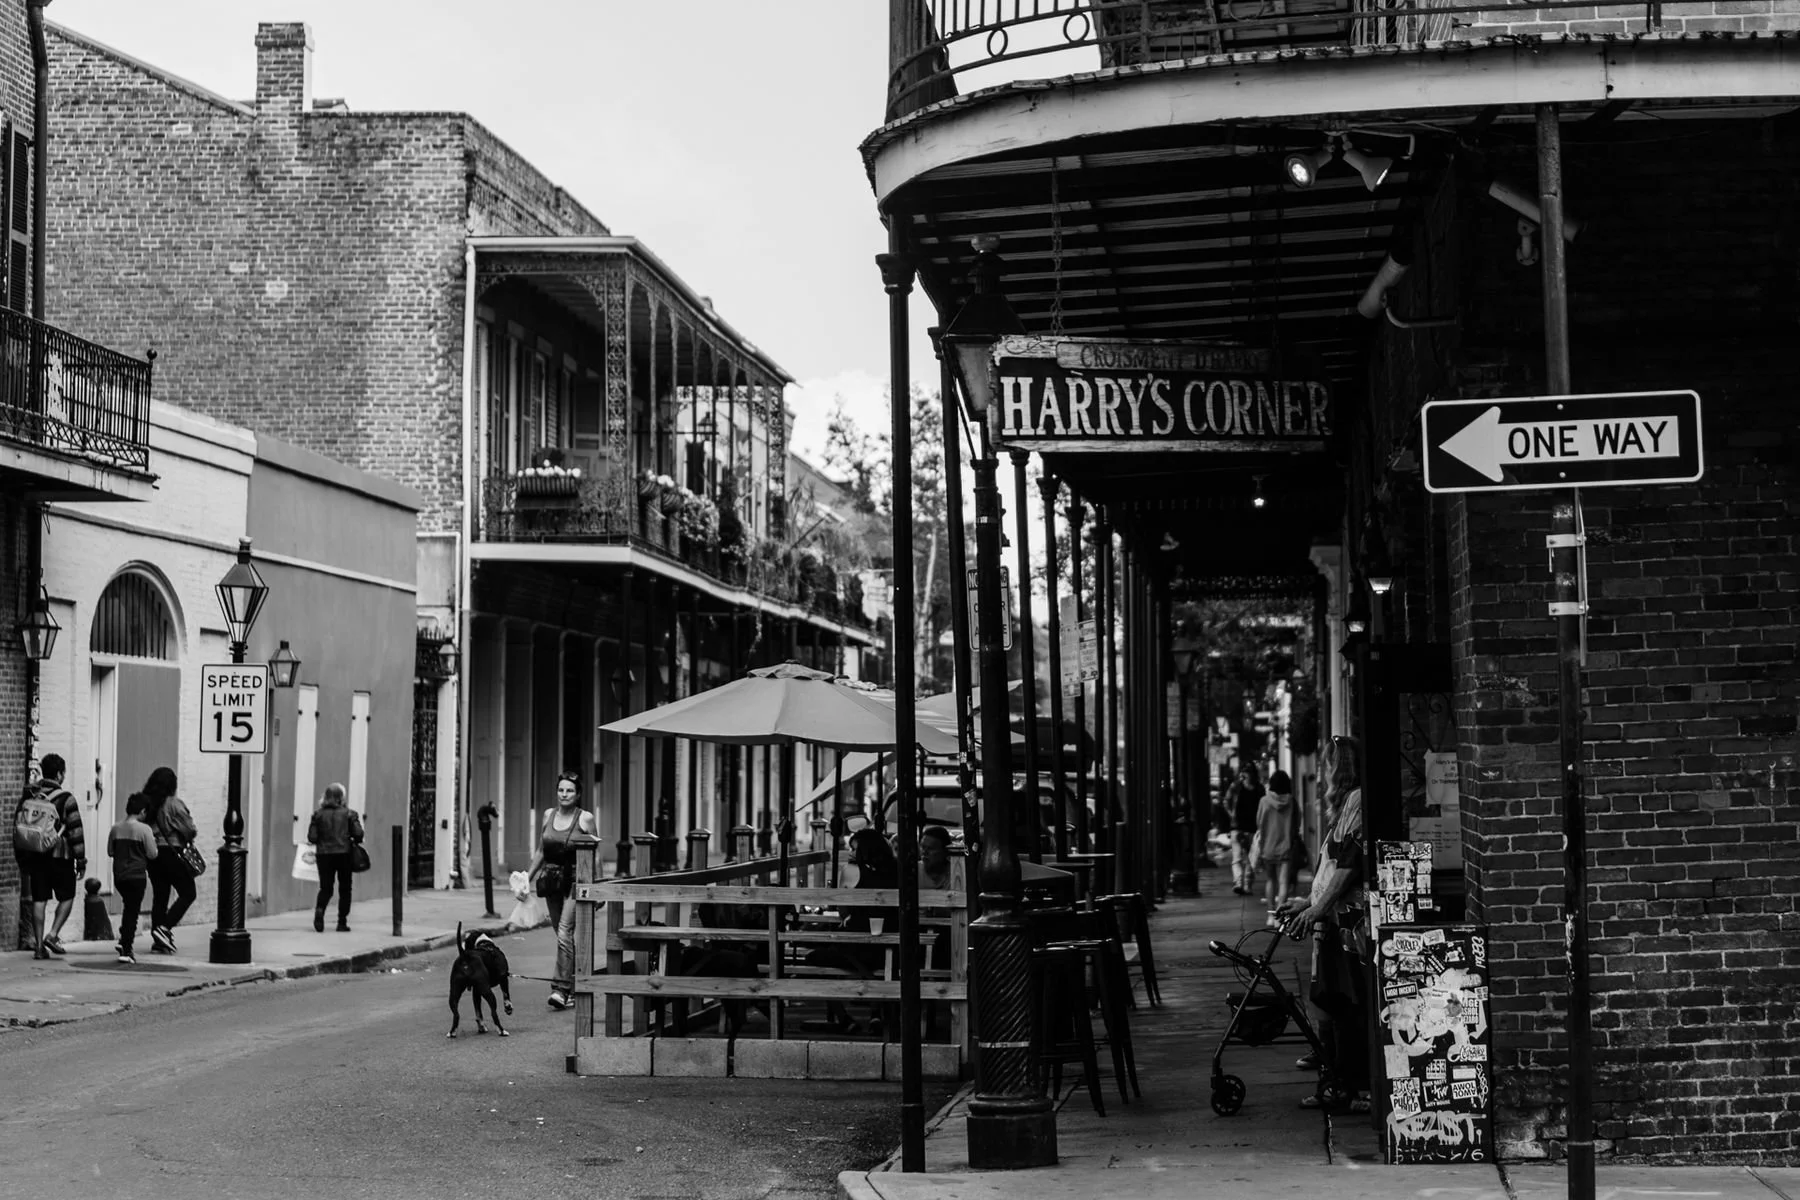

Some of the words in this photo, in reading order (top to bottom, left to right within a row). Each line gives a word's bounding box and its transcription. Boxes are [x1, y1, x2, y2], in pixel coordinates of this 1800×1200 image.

[1000, 373, 1175, 436] HARRY'S
[1183, 380, 1334, 436] CORNER
[1508, 425, 1579, 459] ONE
[1594, 420, 1668, 456] WAY
[207, 674, 263, 689] SPEED
[212, 692, 256, 707] LIMIT
[213, 711, 254, 743] 15
[1452, 1081, 1475, 1091] AWOL
